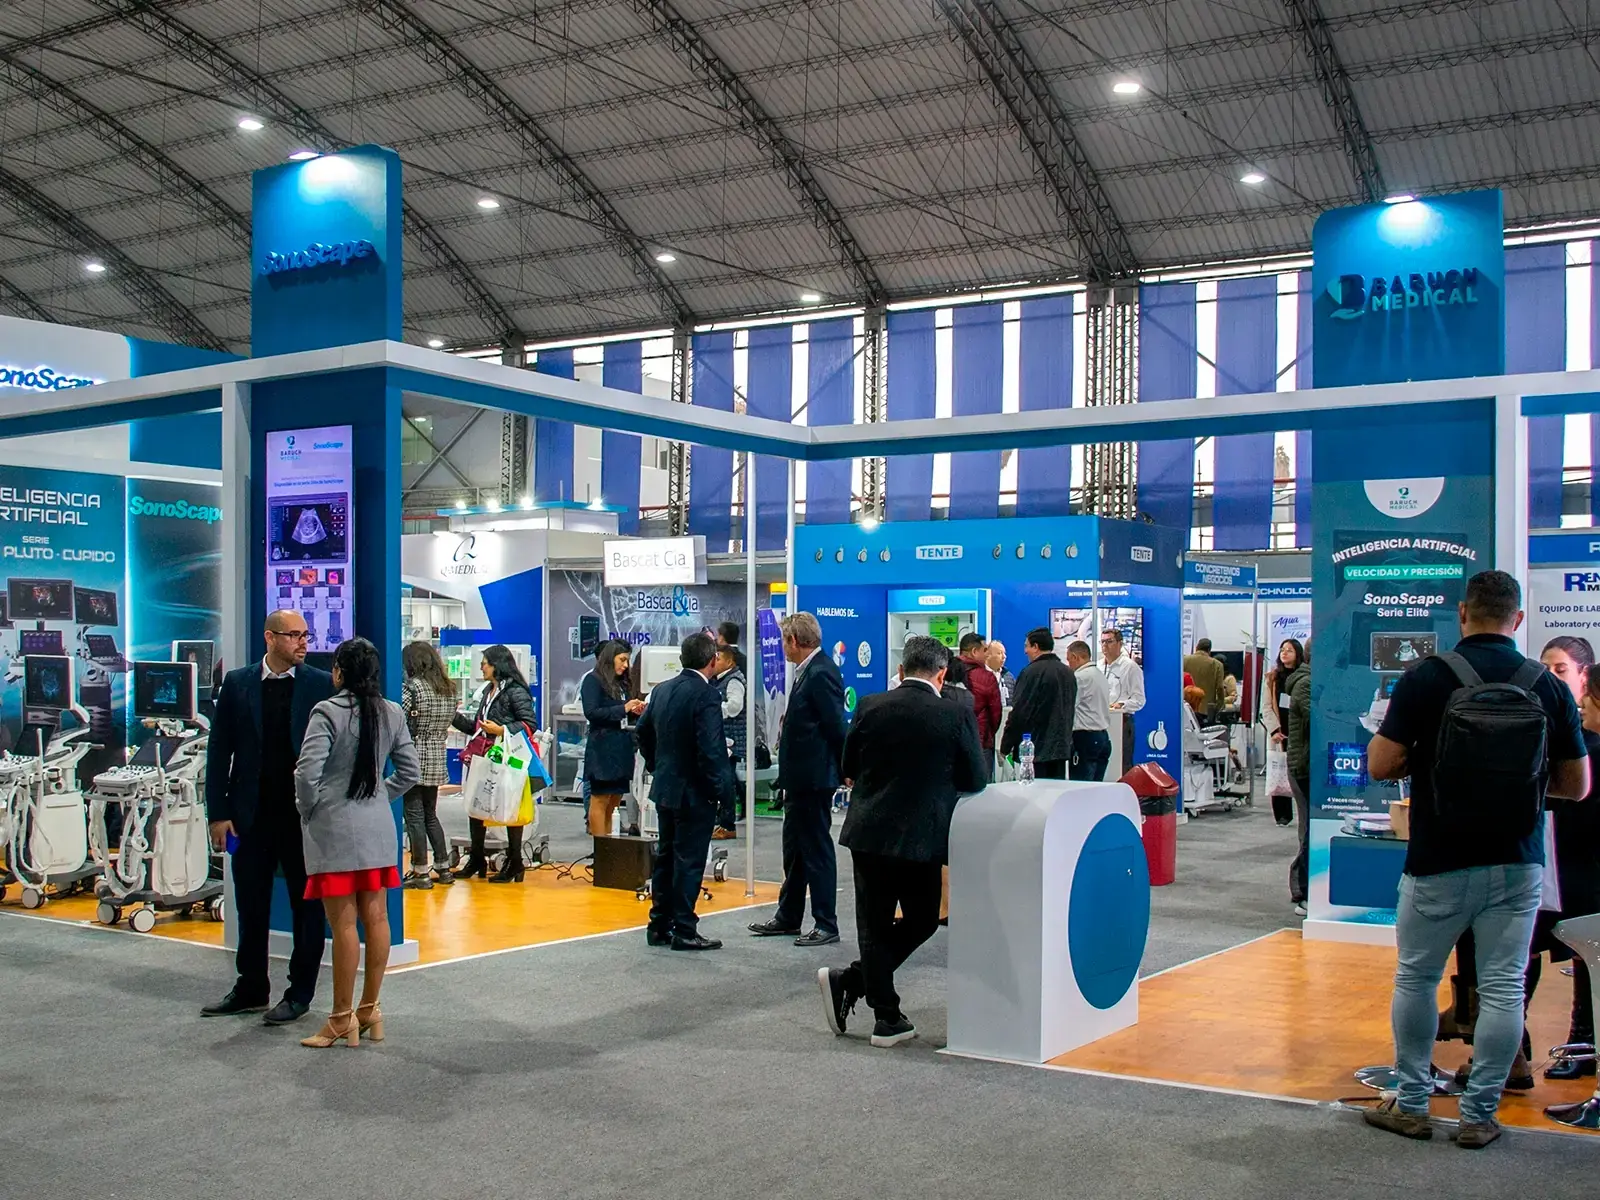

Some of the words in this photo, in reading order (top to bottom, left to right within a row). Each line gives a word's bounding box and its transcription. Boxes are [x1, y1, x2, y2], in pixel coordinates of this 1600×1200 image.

[1372, 286, 1478, 311] MEDICAL
[22, 535, 50, 544] SERIE
[4, 545, 54, 560] PLUTO
[63, 548, 115, 562] CUPIDO
[920, 547, 959, 557] TENTE
[1133, 548, 1151, 560] TENTE
[1332, 538, 1411, 563] INTELIGENCIA
[1412, 538, 1477, 560] ARTIFICIAL
[613, 552, 658, 568] Bascat
[664, 550, 686, 567] Cia
[1195, 563, 1240, 576] CONCRETEMOS
[1346, 568, 1400, 577] VELOCIDAD
[1402, 568, 1409, 576] Y
[1410, 565, 1463, 576] PRECISIÓN
[1203, 575, 1232, 585] NEGOCIOS
[1363, 592, 1444, 607] SonoScape
[817, 607, 847, 617] HABLEMOS
[1377, 607, 1403, 617] Serie
[1406, 607, 1429, 617] Elite
[1539, 605, 1571, 614] EQUIPO
[1272, 616, 1299, 628] Agua
[1545, 621, 1591, 629] Laboratory
[1334, 758, 1360, 770] CPU
